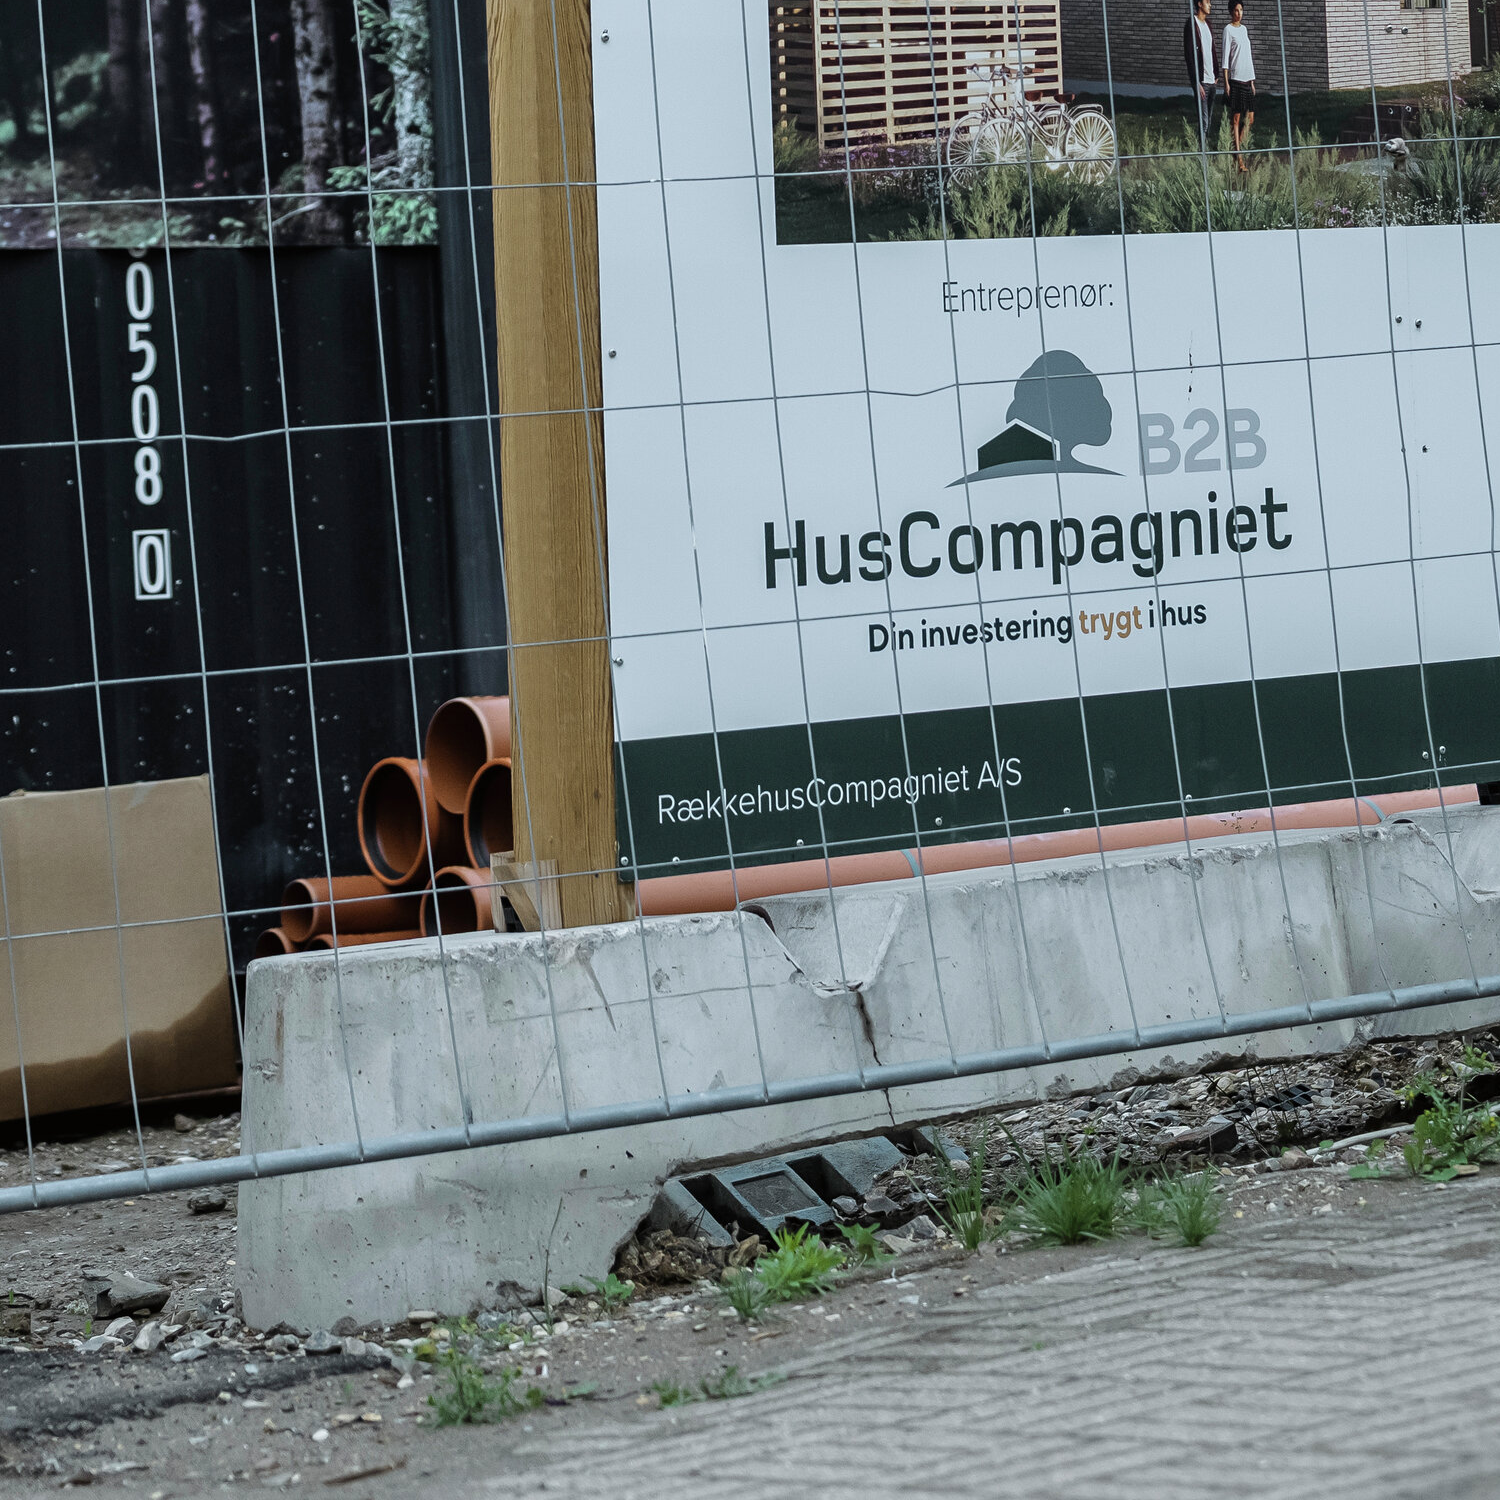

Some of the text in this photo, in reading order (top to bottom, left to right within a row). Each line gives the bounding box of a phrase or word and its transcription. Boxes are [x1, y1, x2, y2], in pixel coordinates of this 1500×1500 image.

[942, 279, 1114, 317] Entreprenør:
[125, 248, 163, 505] 0508
[1138, 407, 1268, 476] B2B
[763, 486, 1294, 589] HusCompagniet
[868, 599, 1208, 653] Din investering trygt i hus
[657, 757, 1023, 824] RækkehusCompagniet A/S
